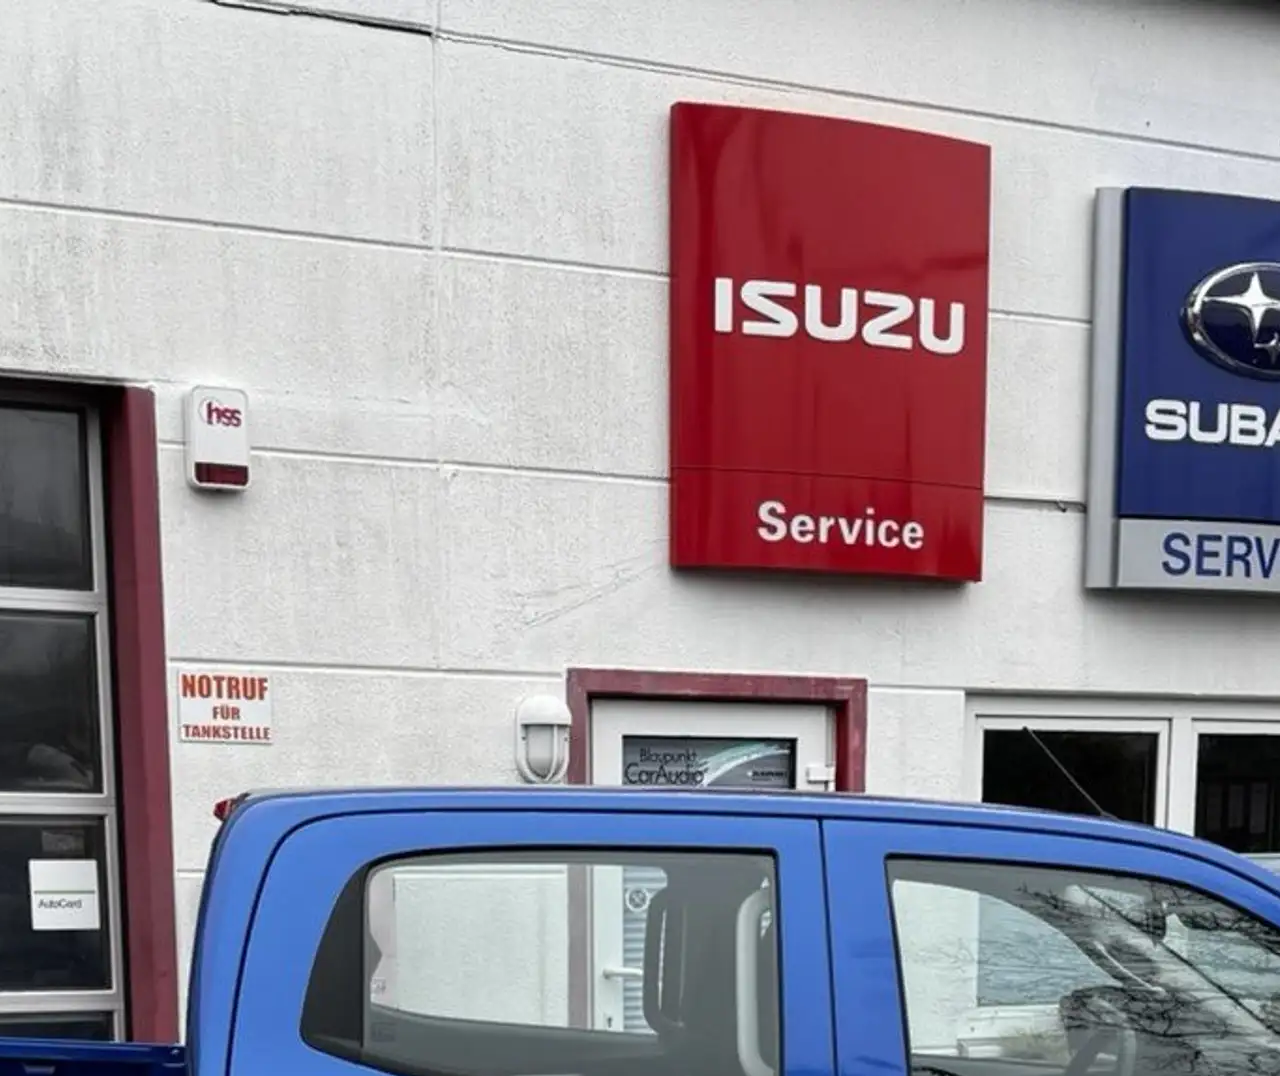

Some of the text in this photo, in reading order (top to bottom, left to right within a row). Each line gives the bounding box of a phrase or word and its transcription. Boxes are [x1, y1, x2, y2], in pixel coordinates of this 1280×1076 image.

[715, 277, 965, 354] ISUZU
[207, 401, 242, 427] hss
[757, 500, 924, 550] Service
[181, 674, 268, 700] NOTRUF
[212, 704, 240, 720] FÜR
[183, 724, 270, 740] TANKSTELLE
[639, 748, 697, 765] Blaupunkt
[624, 763, 705, 785] CarAudio
